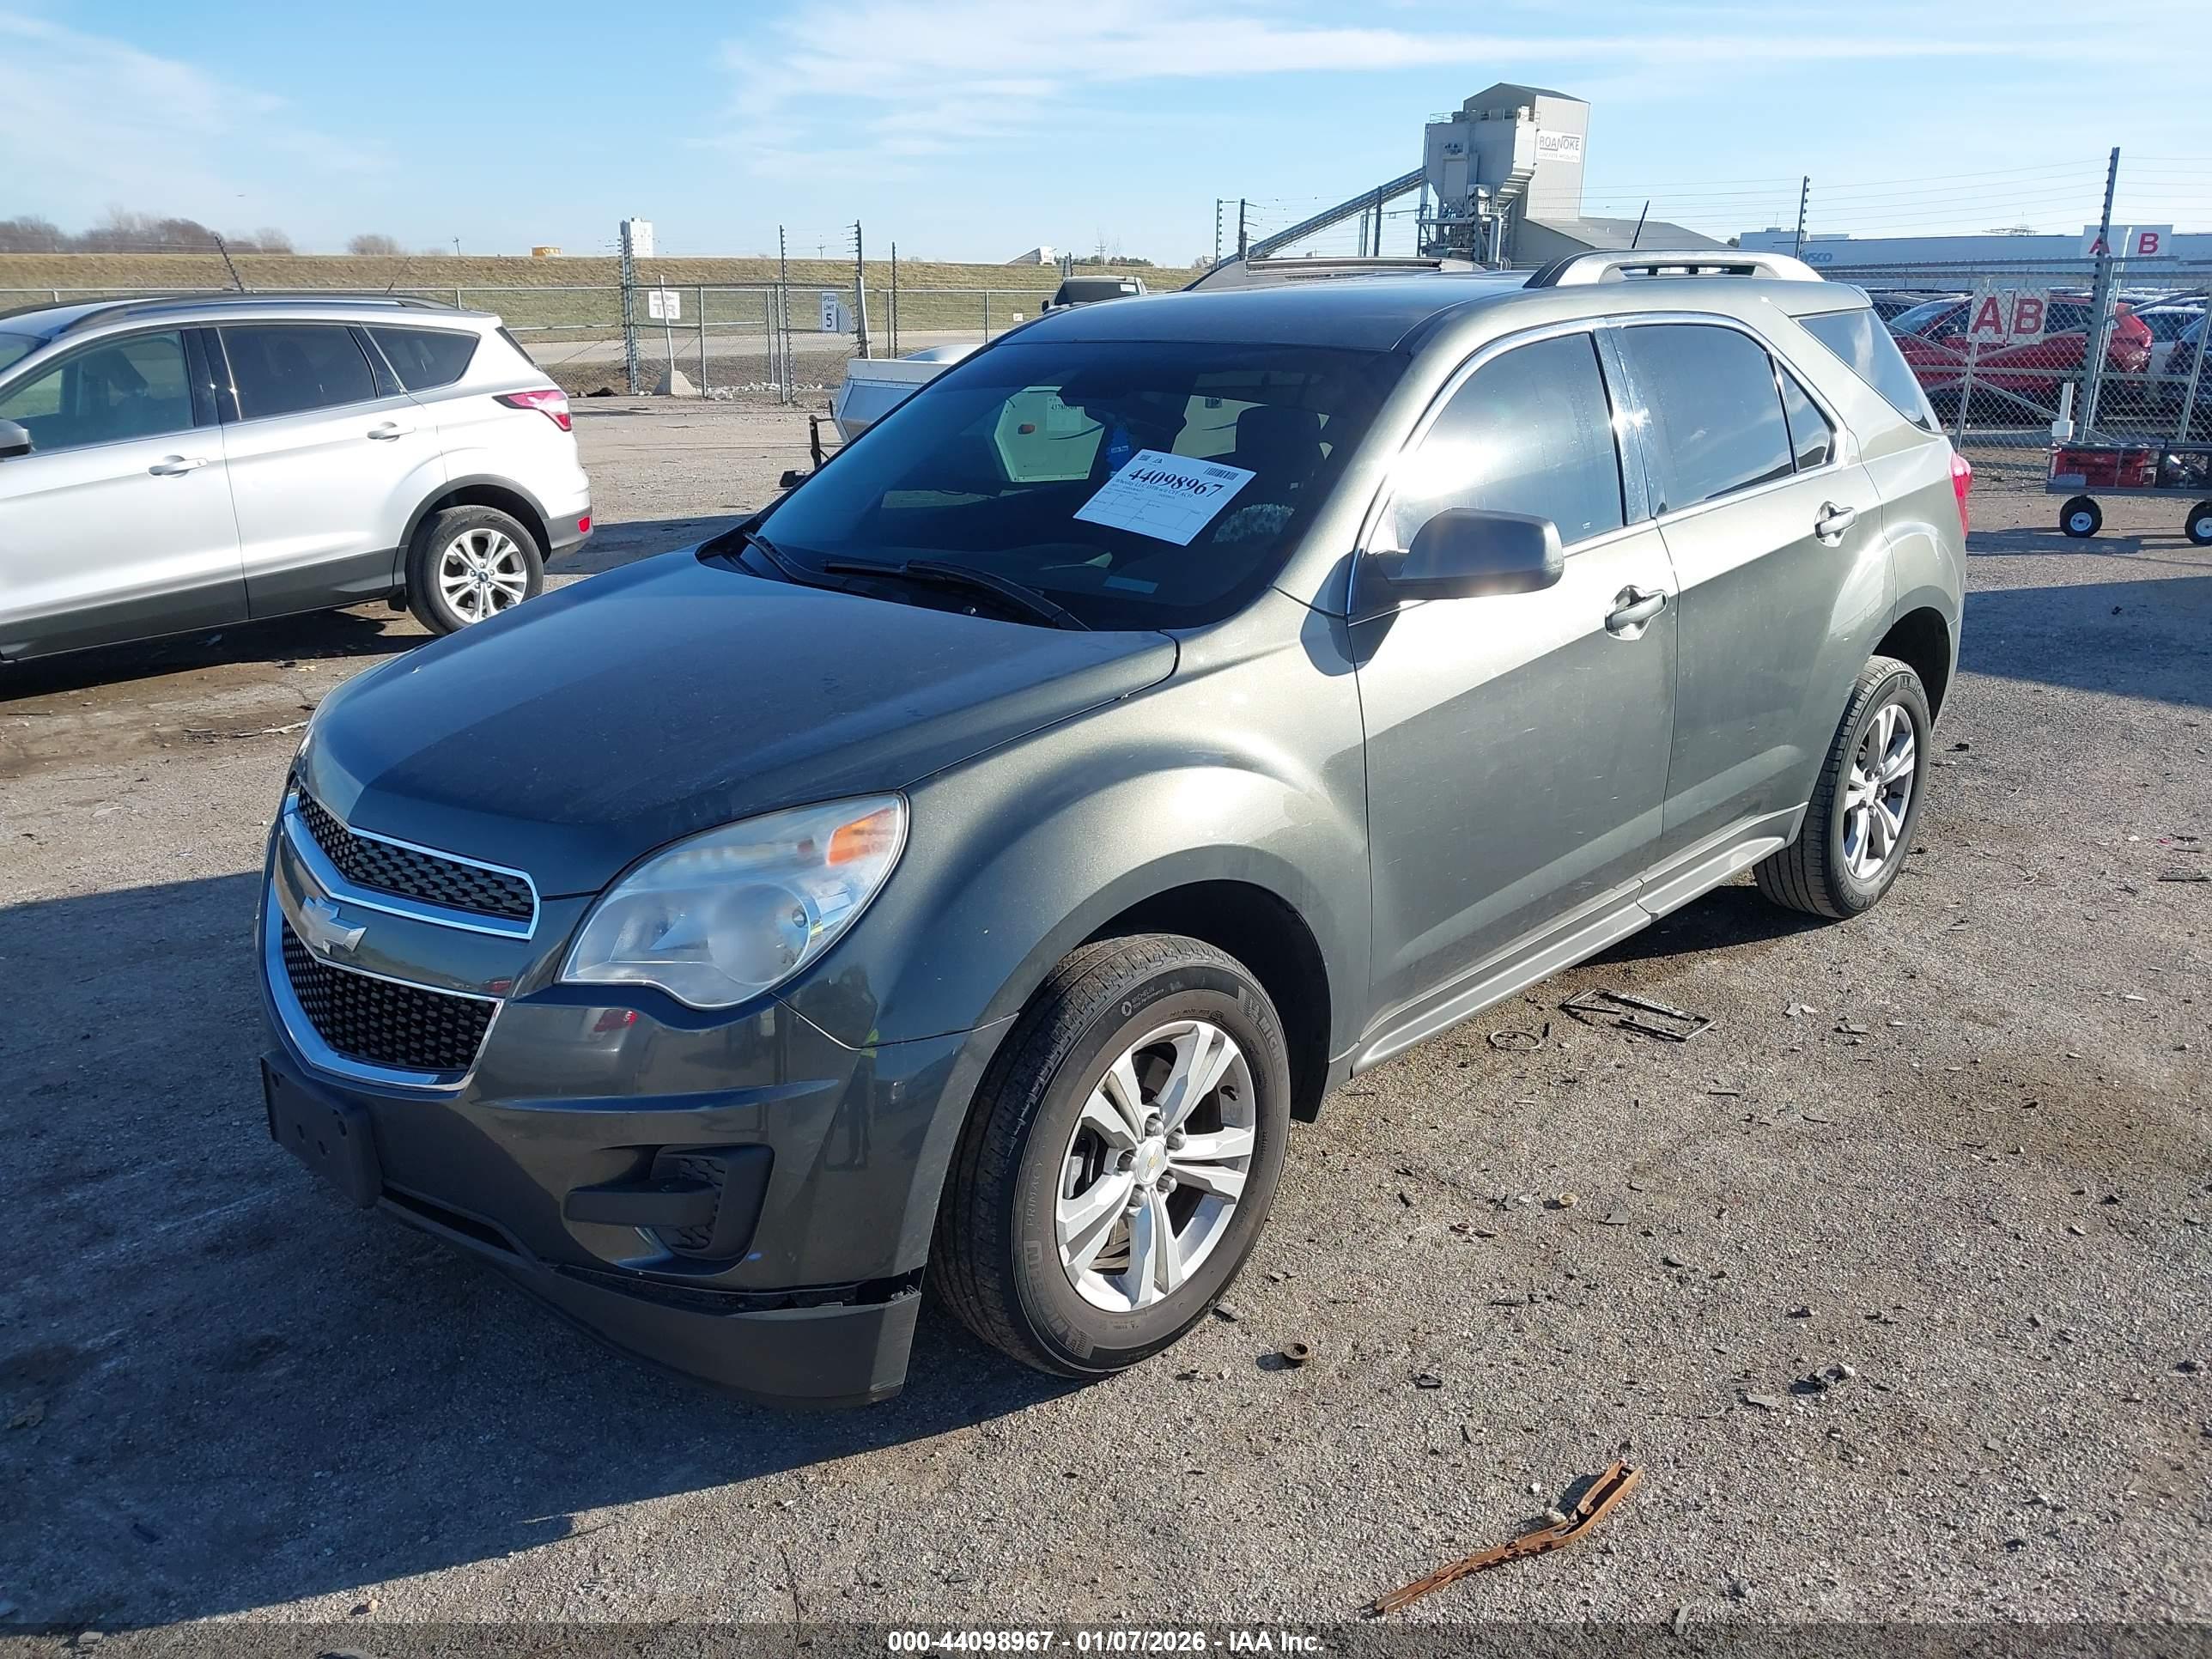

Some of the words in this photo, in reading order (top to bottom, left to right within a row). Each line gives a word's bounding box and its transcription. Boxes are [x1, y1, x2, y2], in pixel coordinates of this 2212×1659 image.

[1539, 136, 1580, 151] ROANOKE
[2138, 233, 2160, 254] B
[826, 313, 833, 328] 5
[1971, 296, 2002, 335] A
[2013, 298, 2044, 335] B
[1128, 467, 1224, 498] 44098967
[1025, 1160, 1043, 1226] PRIMACY
